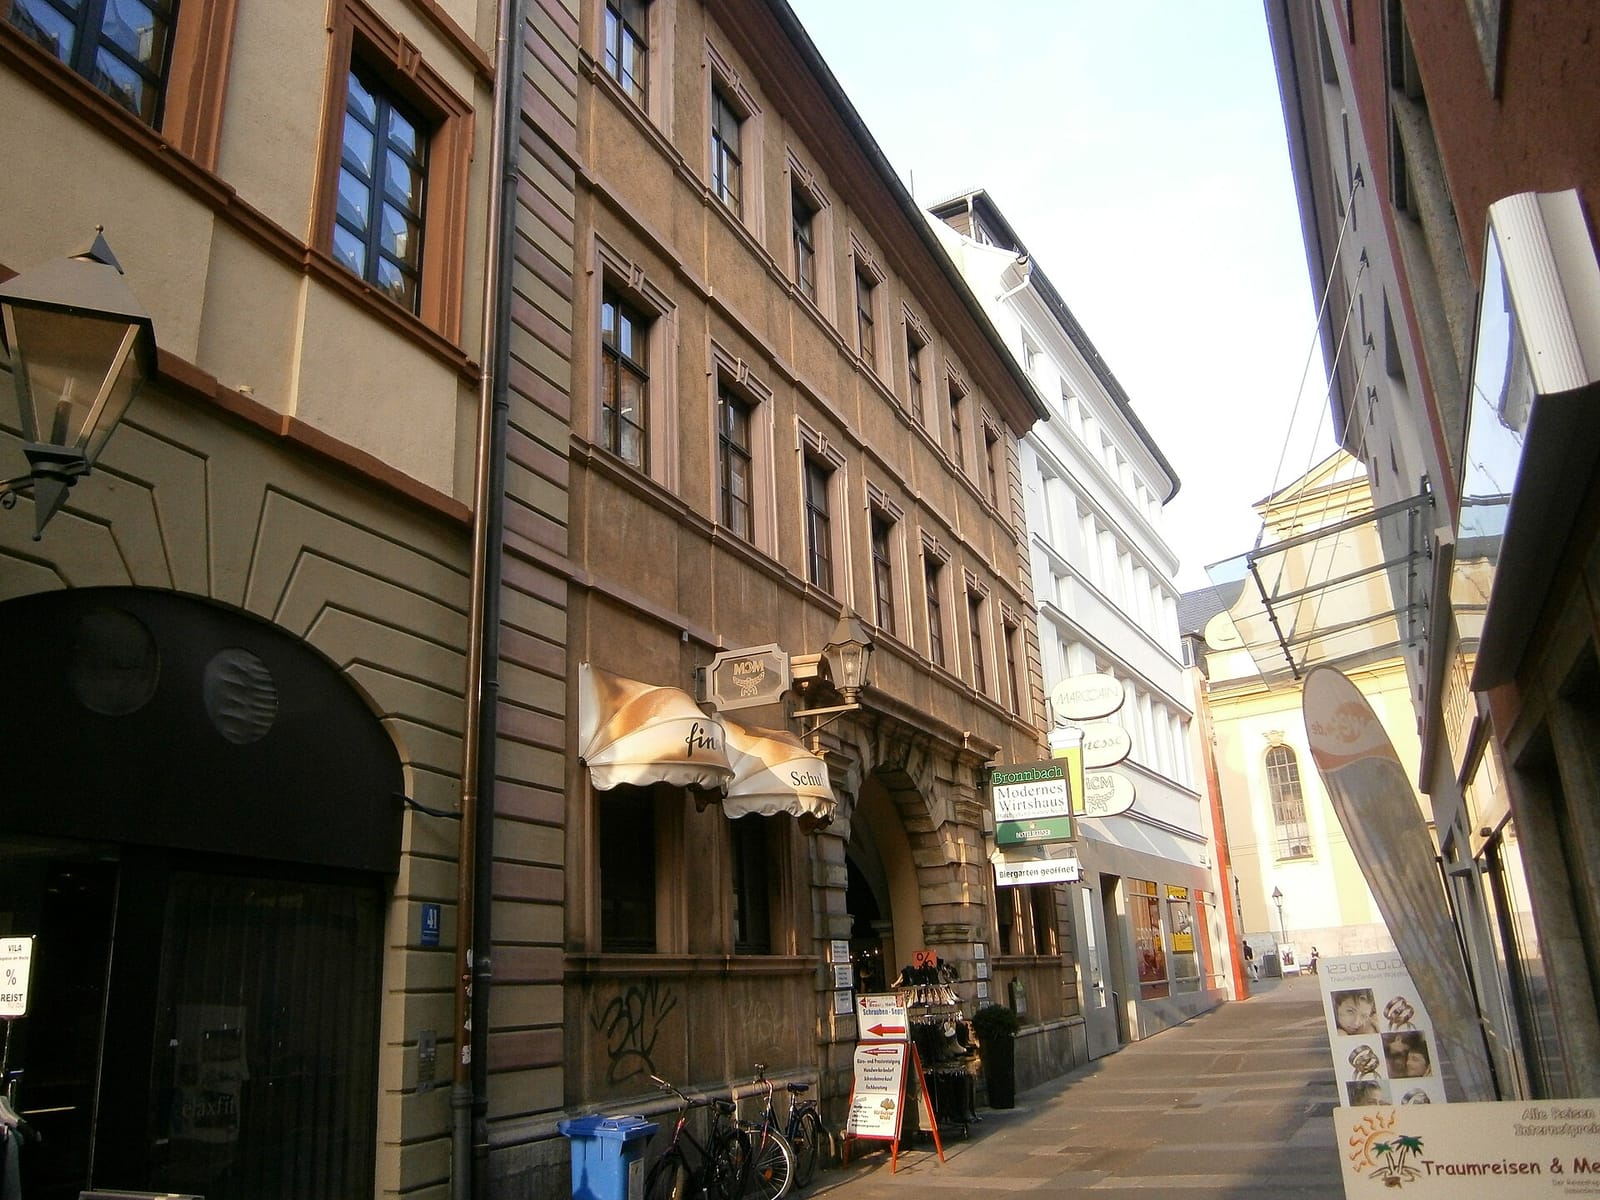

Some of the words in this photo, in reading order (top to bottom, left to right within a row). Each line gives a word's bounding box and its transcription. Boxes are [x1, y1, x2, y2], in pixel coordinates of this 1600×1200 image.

[790, 771, 825, 786] Schu
[992, 765, 1063, 785] Bronnbach
[998, 784, 1064, 800] Modernes
[999, 797, 1065, 812] Wirtshaus
[999, 866, 1039, 879] Biergarten
[427, 908, 437, 929] 41
[1421, 1159, 1542, 1177] Traumreisen
[1550, 1157, 1564, 1174] &
